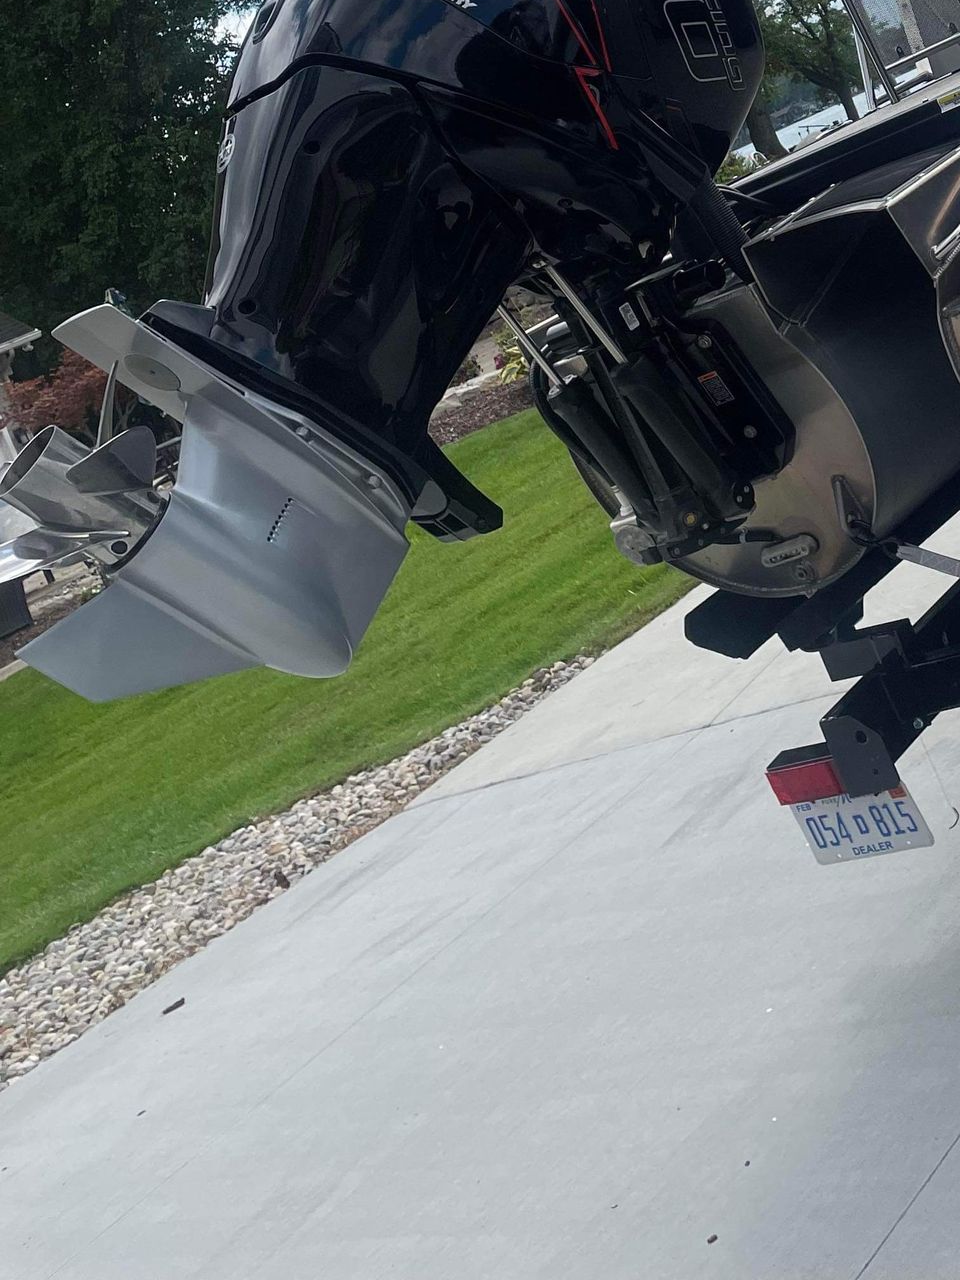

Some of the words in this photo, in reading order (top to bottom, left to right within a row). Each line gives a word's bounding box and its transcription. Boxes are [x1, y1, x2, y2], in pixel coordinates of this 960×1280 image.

[797, 804, 812, 812] FEB
[806, 813, 853, 849] 054
[853, 815, 869, 834] D
[869, 802, 918, 837] 815
[853, 842, 894, 856] DEALER
